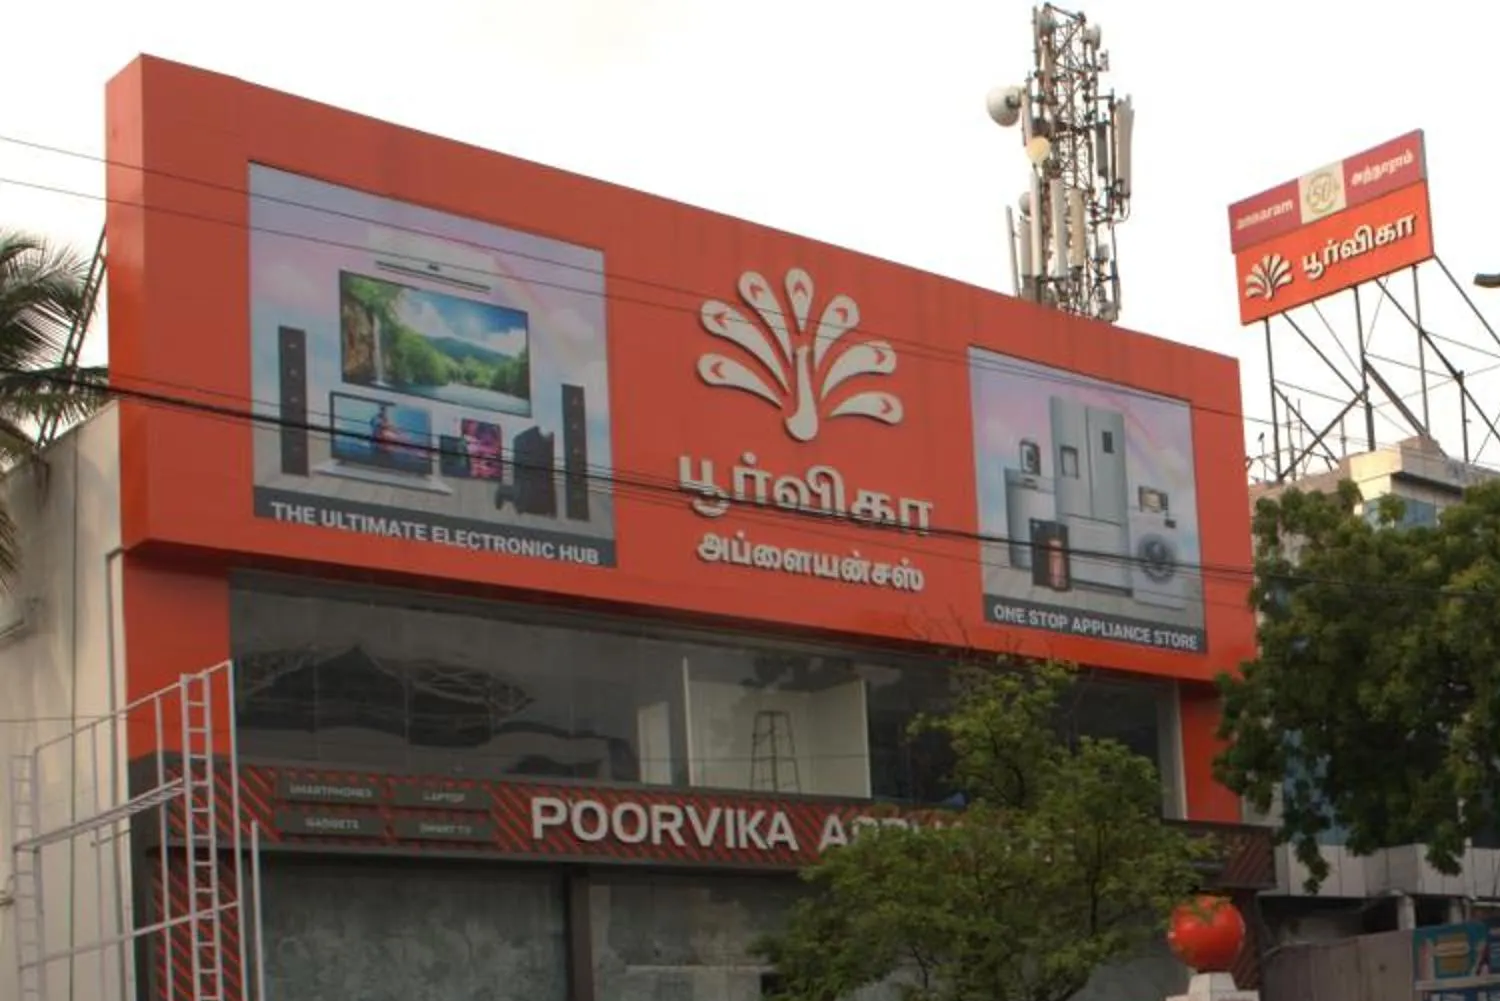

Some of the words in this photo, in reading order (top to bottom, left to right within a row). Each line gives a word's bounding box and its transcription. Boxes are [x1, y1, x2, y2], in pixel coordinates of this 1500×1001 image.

[1303, 214, 1416, 281] பூர்விகா
[679, 451, 933, 535] பூர்விகா
[271, 501, 317, 525] THE
[321, 509, 427, 542] ULTIMATE
[431, 525, 555, 561] ELECTRONIC
[559, 542, 599, 565] HUB
[994, 603, 1026, 624] ONE
[1029, 609, 1069, 629] STOP
[1072, 615, 1152, 645] APPLIANCE
[1154, 630, 1199, 650] STORE
[530, 795, 799, 852] POORVIKA
